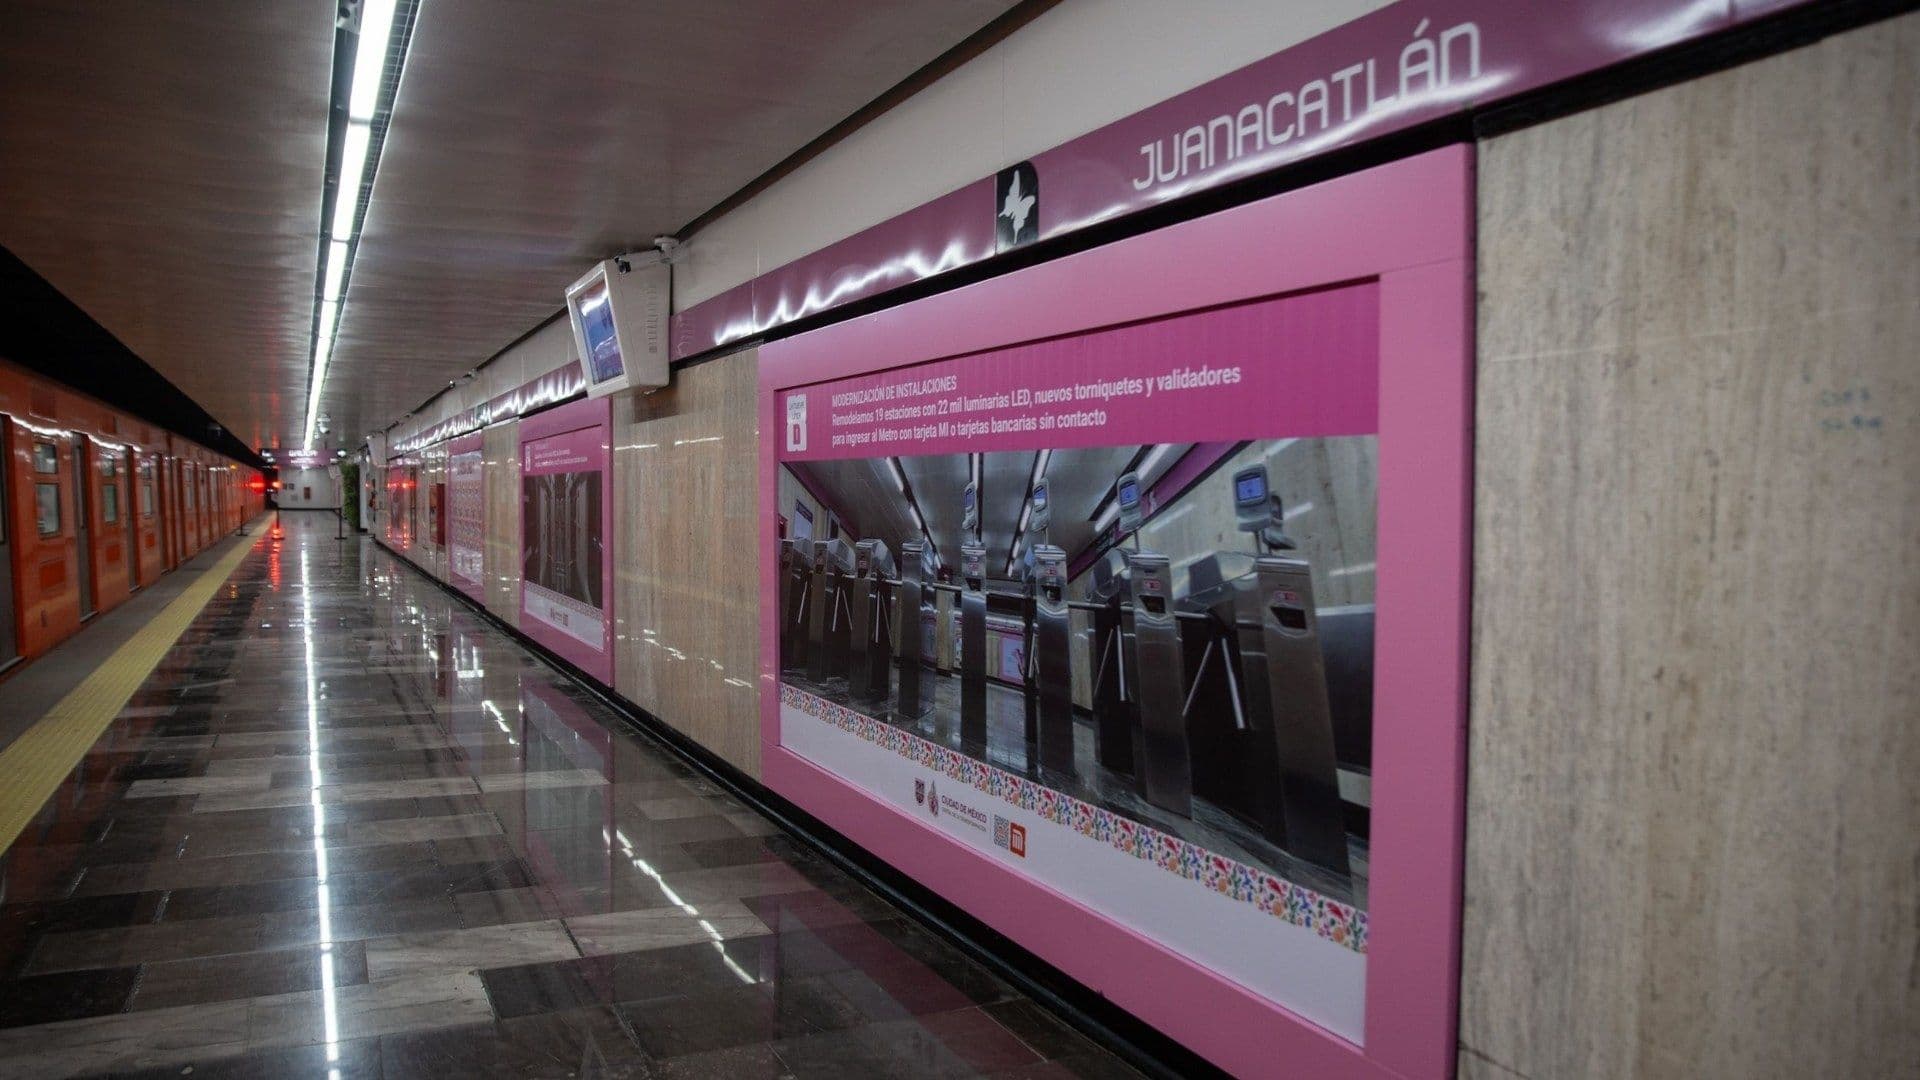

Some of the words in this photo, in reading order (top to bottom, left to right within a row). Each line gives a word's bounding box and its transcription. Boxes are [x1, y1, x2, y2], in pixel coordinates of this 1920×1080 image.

[1133, 18, 1480, 190] JUANACATLÁN
[832, 384, 885, 408] MODERNIZACIÓN
[886, 386, 895, 400] DE
[896, 375, 957, 399] INSTALACIONES
[832, 411, 874, 426] Remodelamos
[875, 408, 884, 421] 19
[885, 404, 921, 420] estaciones
[922, 405, 937, 416] con
[938, 399, 948, 415] 22
[949, 397, 962, 413] mil
[964, 393, 1010, 412] luminarias
[1011, 389, 1032, 408] LED,
[1034, 386, 1072, 404] nuevos
[1075, 378, 1143, 401] torniquetes
[1145, 377, 1155, 397] y
[1156, 365, 1241, 391] validadores
[832, 434, 846, 448] para
[846, 431, 871, 447] ingresar
[871, 428, 878, 442] al
[878, 428, 898, 442] Metro
[899, 429, 913, 440] con
[913, 424, 937, 441] tarjeta
[938, 422, 949, 437] MI
[950, 424, 956, 436] o
[957, 419, 989, 439] tarjetas
[991, 414, 1037, 433] bancarias
[1039, 412, 1055, 430] sin
[1057, 409, 1107, 429] contacto
